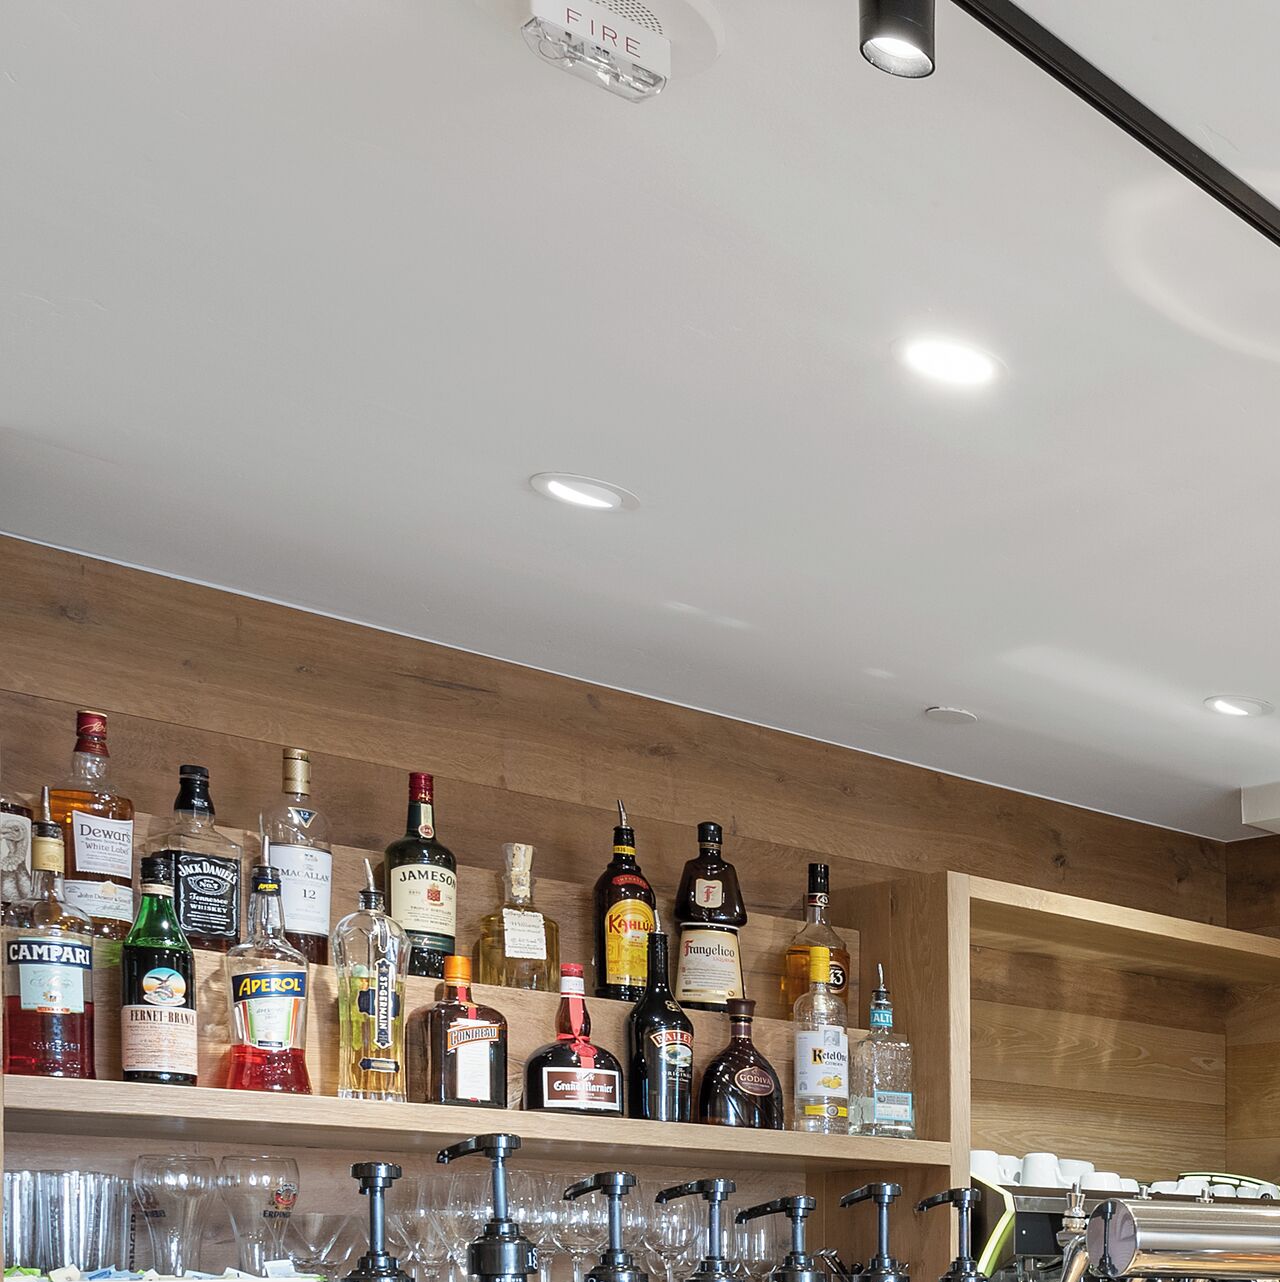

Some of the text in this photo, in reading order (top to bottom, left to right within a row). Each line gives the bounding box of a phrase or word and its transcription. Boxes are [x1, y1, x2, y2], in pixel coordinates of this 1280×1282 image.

[566, 7, 641, 59] FIRE
[80, 824, 131, 842] Dewar's
[85, 841, 110, 852] White
[177, 861, 238, 885] JACK DANIEL'S
[302, 888, 316, 900] 12
[703, 885, 717, 902] F
[189, 903, 227, 913] WHISKEY
[9, 943, 90, 966] CAMPARI
[683, 939, 735, 957] Frangelico
[239, 976, 302, 997] APEROL
[377, 975, 389, 1031] ST-GERMAIN
[450, 1027, 497, 1047] COINTREAU
[812, 1049, 835, 1064] Ketel
[586, 1081, 614, 1094] Marnier
[740, 1073, 772, 1087] GODIVA
